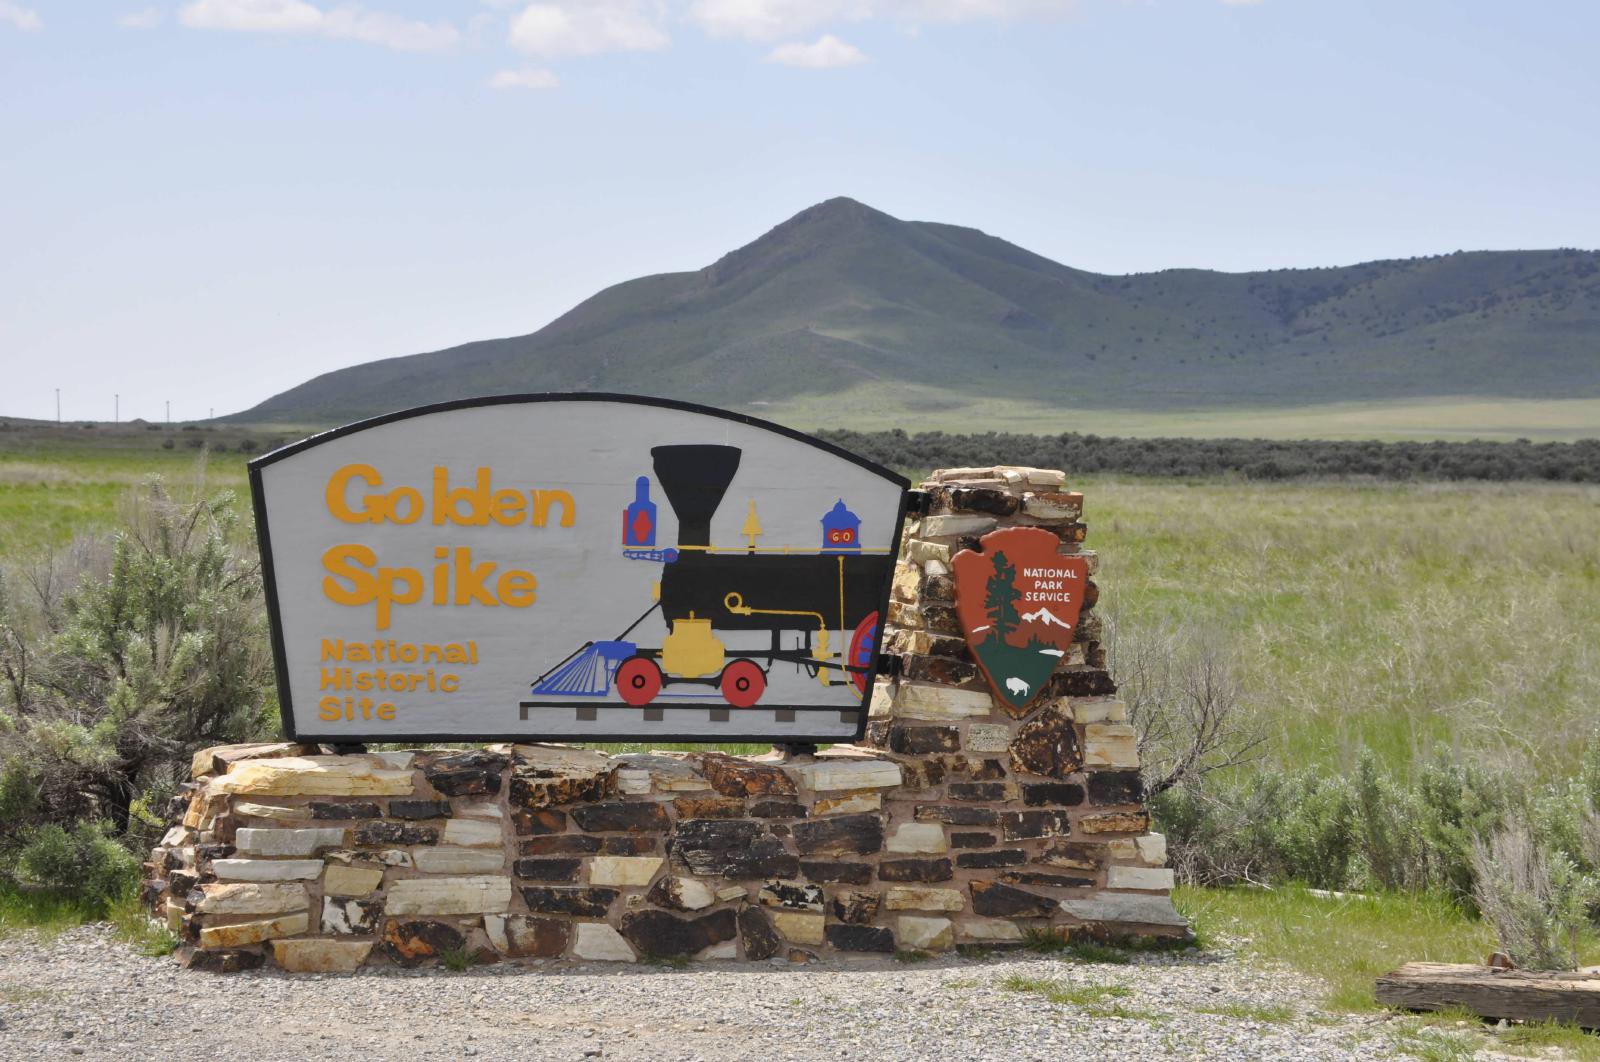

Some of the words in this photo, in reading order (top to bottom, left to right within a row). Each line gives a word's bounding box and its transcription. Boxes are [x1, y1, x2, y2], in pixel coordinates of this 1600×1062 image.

[325, 463, 576, 527] Golden
[1023, 567, 1078, 579] NATIONAL
[1034, 580, 1063, 590] PARK
[321, 543, 538, 630] Spike
[1025, 591, 1071, 603] SERVICE
[320, 638, 478, 664] National
[319, 667, 459, 693] Historic
[319, 695, 396, 721] Site
